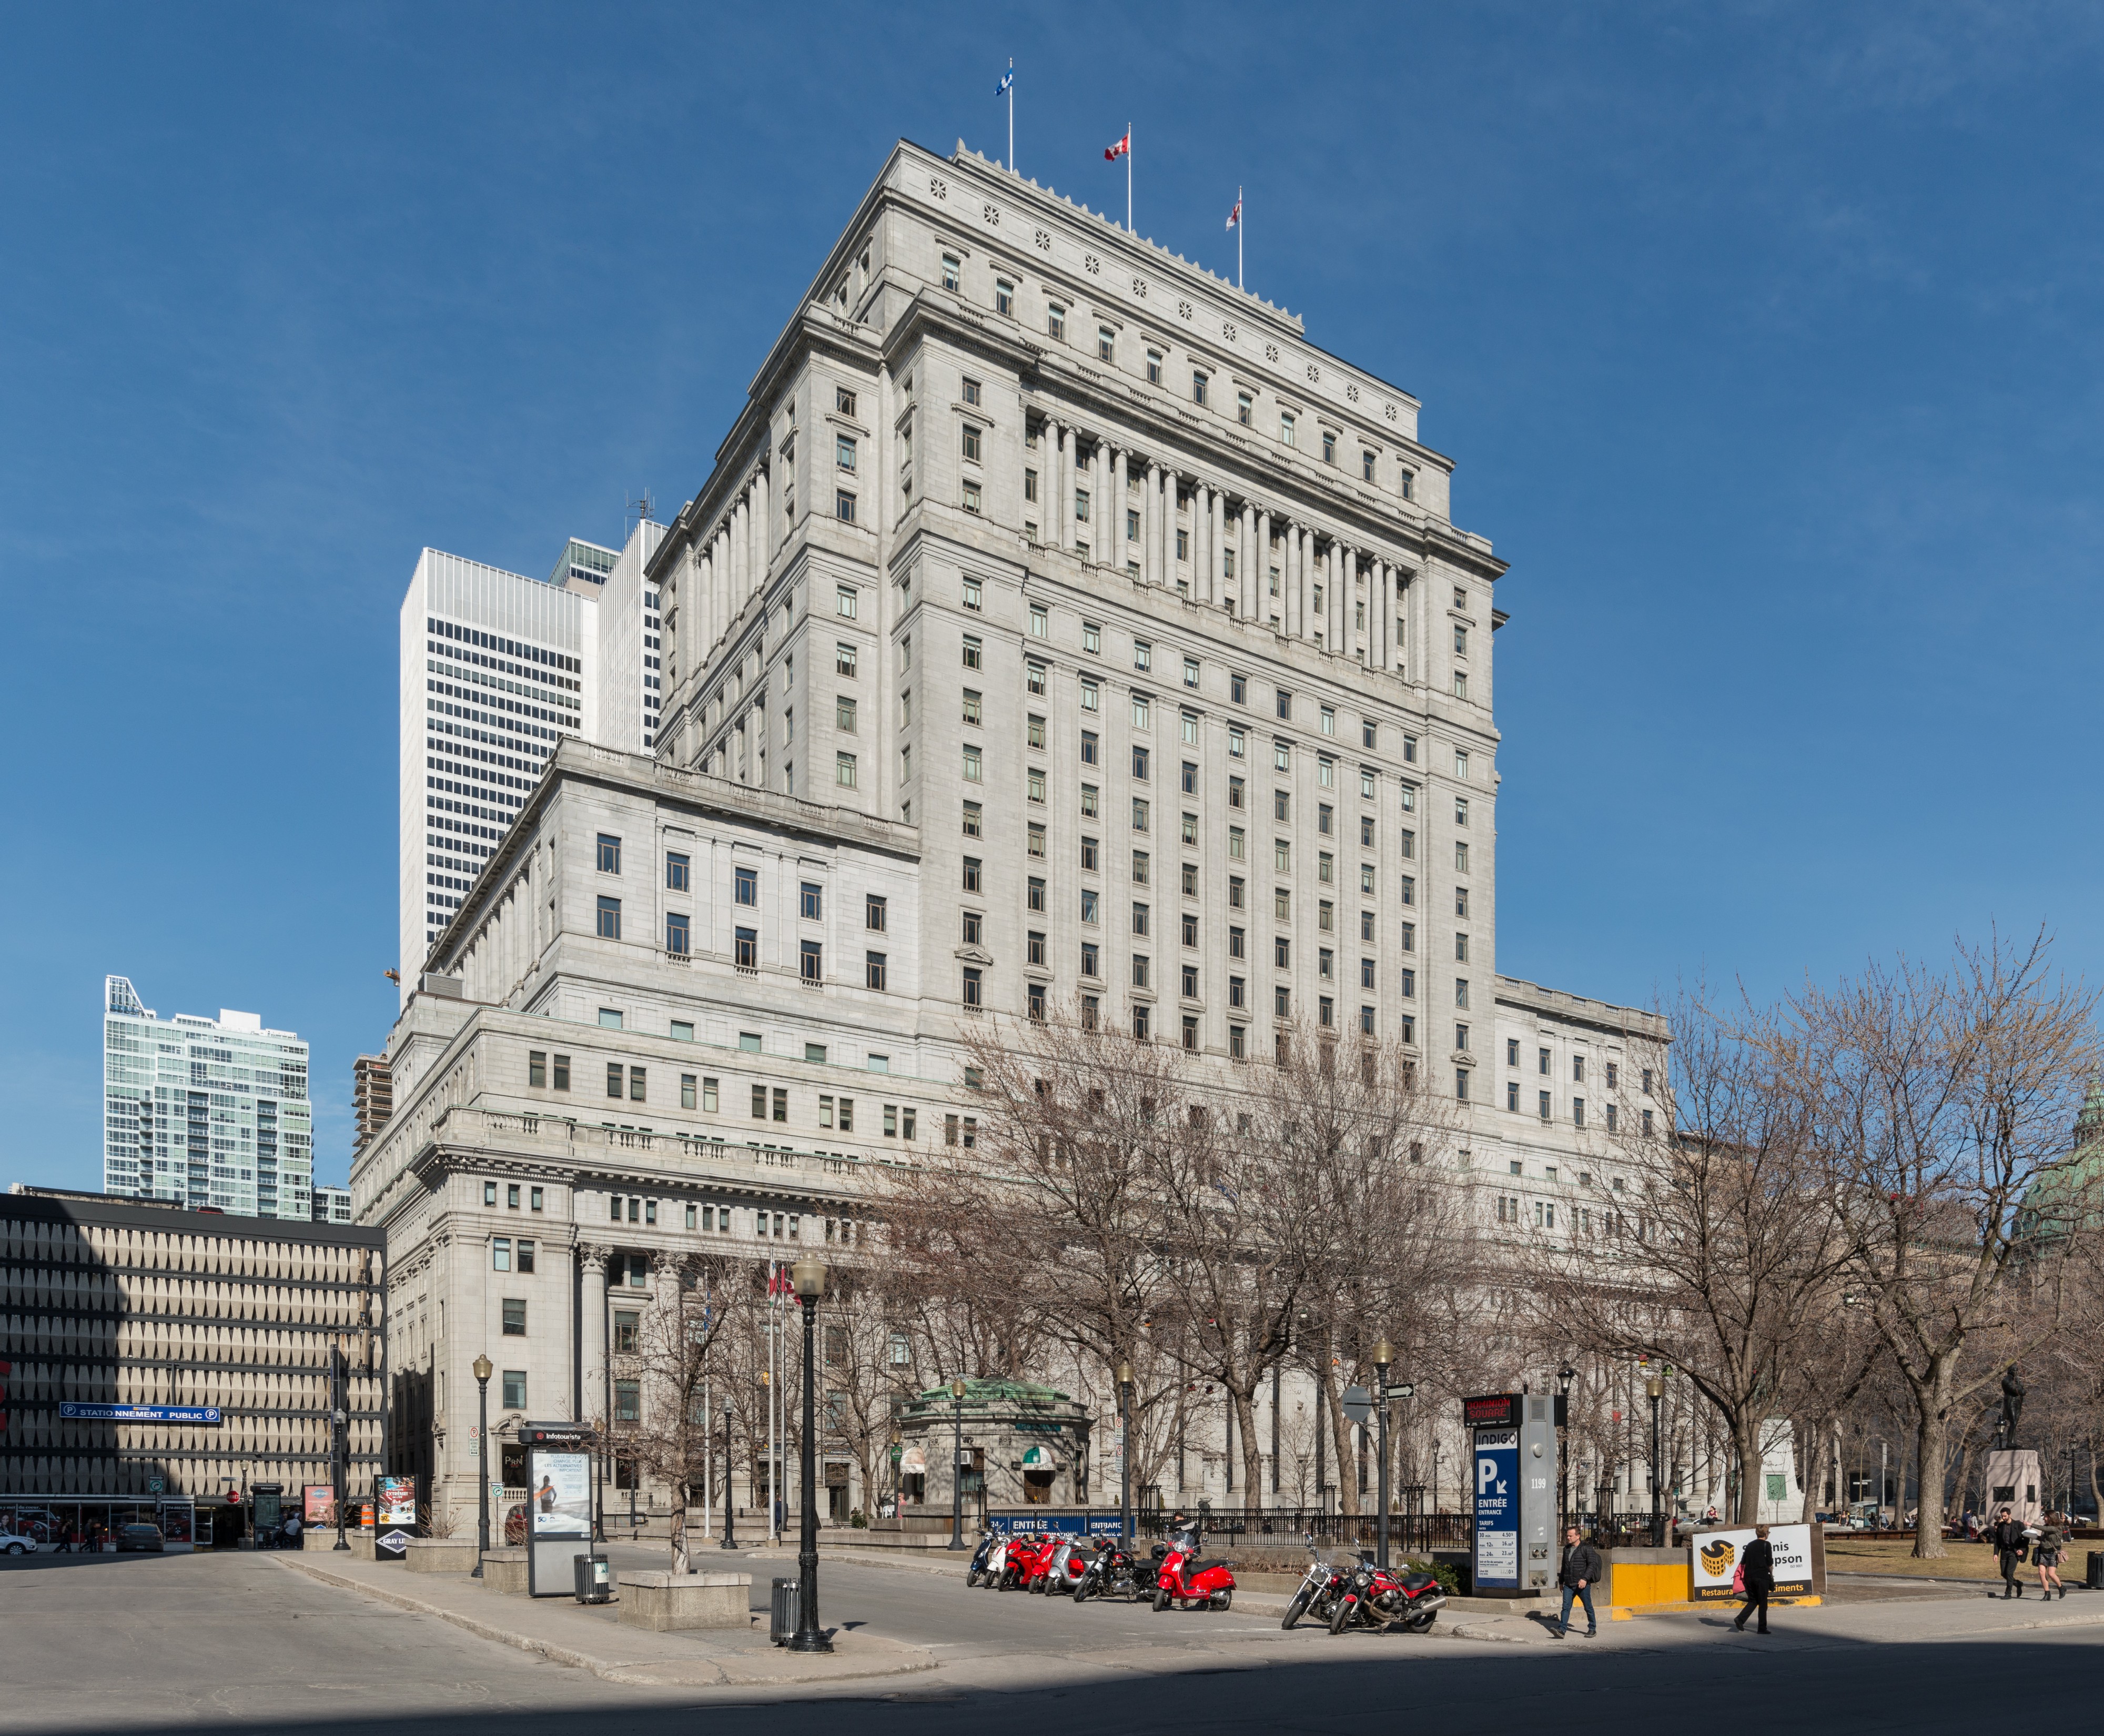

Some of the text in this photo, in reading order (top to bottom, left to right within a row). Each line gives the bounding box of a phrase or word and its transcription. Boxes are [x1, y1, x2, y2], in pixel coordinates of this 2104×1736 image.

[1466, 1398, 1510, 1410] DOMINION
[80, 1409, 163, 1418] STATIONNEMENT
[1469, 1407, 1506, 1419] SQUARE
[1479, 1459, 1498, 1495] P
[1531, 1478, 1546, 1489] 1199
[1478, 1497, 1507, 1508] ENTRÉE
